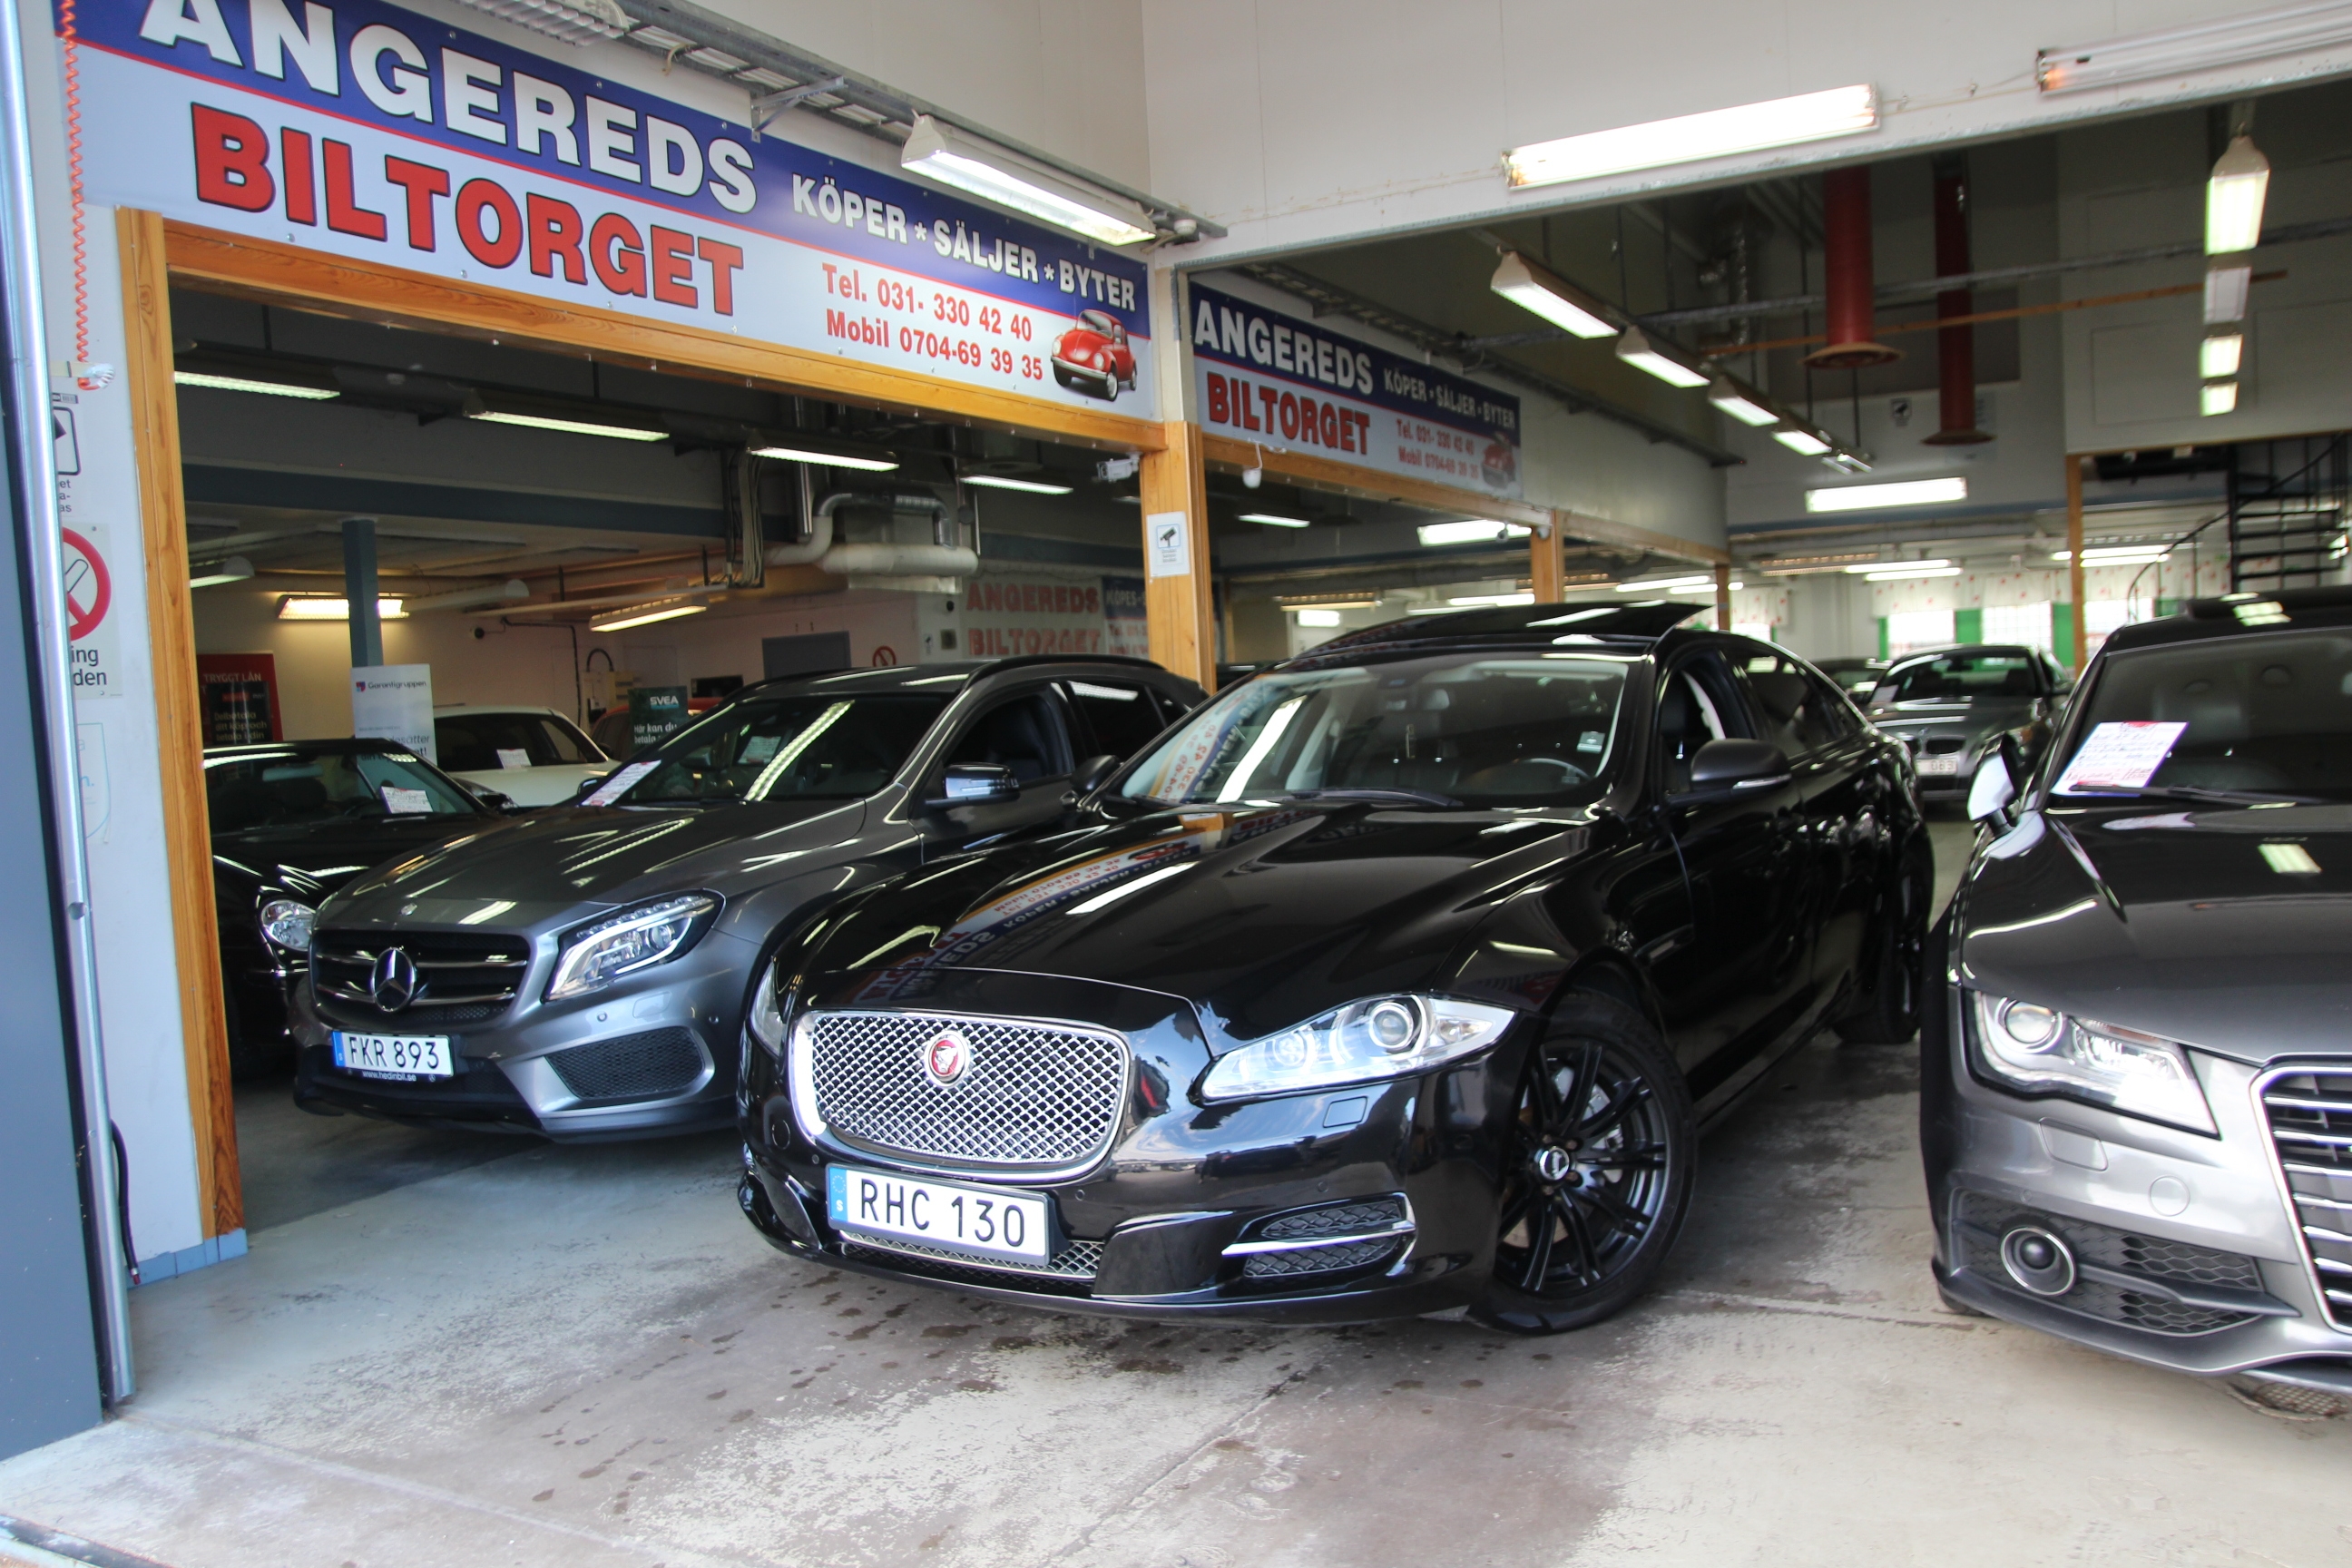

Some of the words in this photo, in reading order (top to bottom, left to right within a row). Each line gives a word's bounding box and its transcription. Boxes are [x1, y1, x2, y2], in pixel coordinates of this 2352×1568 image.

[139, 0, 759, 214] ANGEREDS
[190, 102, 744, 317] BILTORGET
[791, 172, 907, 245] KÖPER
[933, 219, 1040, 284] SÄLJER
[1058, 259, 1136, 312] BYTER
[822, 262, 867, 302] Tel.
[877, 278, 924, 314] 031-
[933, 292, 970, 327] 330
[978, 305, 1002, 335] 42
[1010, 315, 1033, 342] 40
[826, 309, 889, 348] Mobil
[898, 327, 982, 368] 0704-69
[990, 347, 1014, 375] 39
[1021, 354, 1044, 380] 35
[1194, 299, 1375, 396] ANGEREDS
[1207, 371, 1370, 455] BILTORGET
[1384, 368, 1427, 401] KÖPER
[1436, 384, 1476, 416] SÄLJER
[1483, 401, 1515, 429] BYTER
[966, 582, 1100, 613] ANGEREDS
[968, 628, 1101, 655] BILTORGET
[368, 681, 426, 690] Garantigruppen
[650, 695, 679, 706] SVEA
[647, 723, 662, 733] kan
[348, 1036, 389, 1067] FKR
[393, 1041, 440, 1069] 893
[362, 1071, 416, 1082] www.hedinbil.se
[835, 1200, 844, 1211] S
[861, 1179, 931, 1230] RHC
[951, 1195, 1025, 1247] 130
